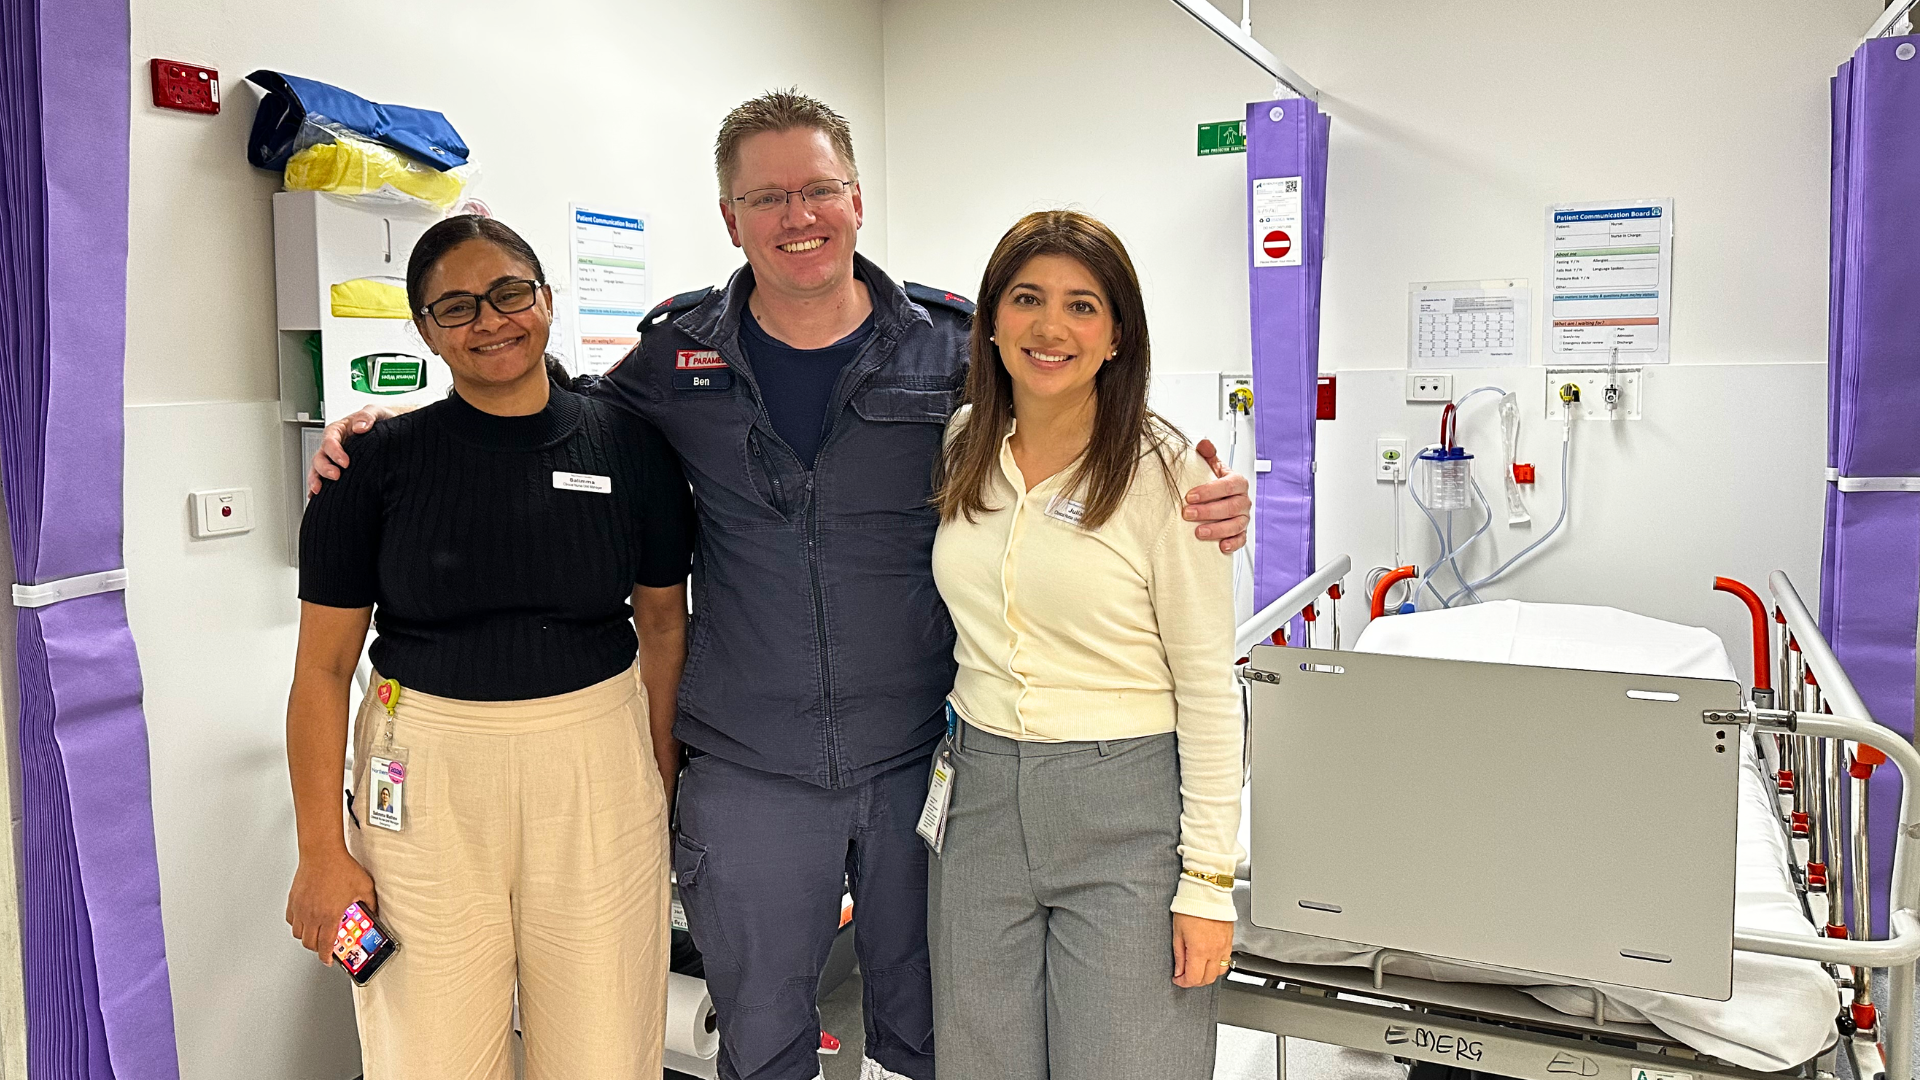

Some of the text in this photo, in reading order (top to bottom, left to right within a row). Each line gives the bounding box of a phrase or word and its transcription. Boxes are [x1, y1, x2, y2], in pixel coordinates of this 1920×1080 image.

[577, 214, 592, 222] Patient
[593, 217, 625, 226] Communication
[1580, 211, 1630, 220] Communication
[693, 377, 710, 386] Ben
[1384, 1025, 1483, 1061] EMERG
[1546, 1051, 1600, 1076] ED
